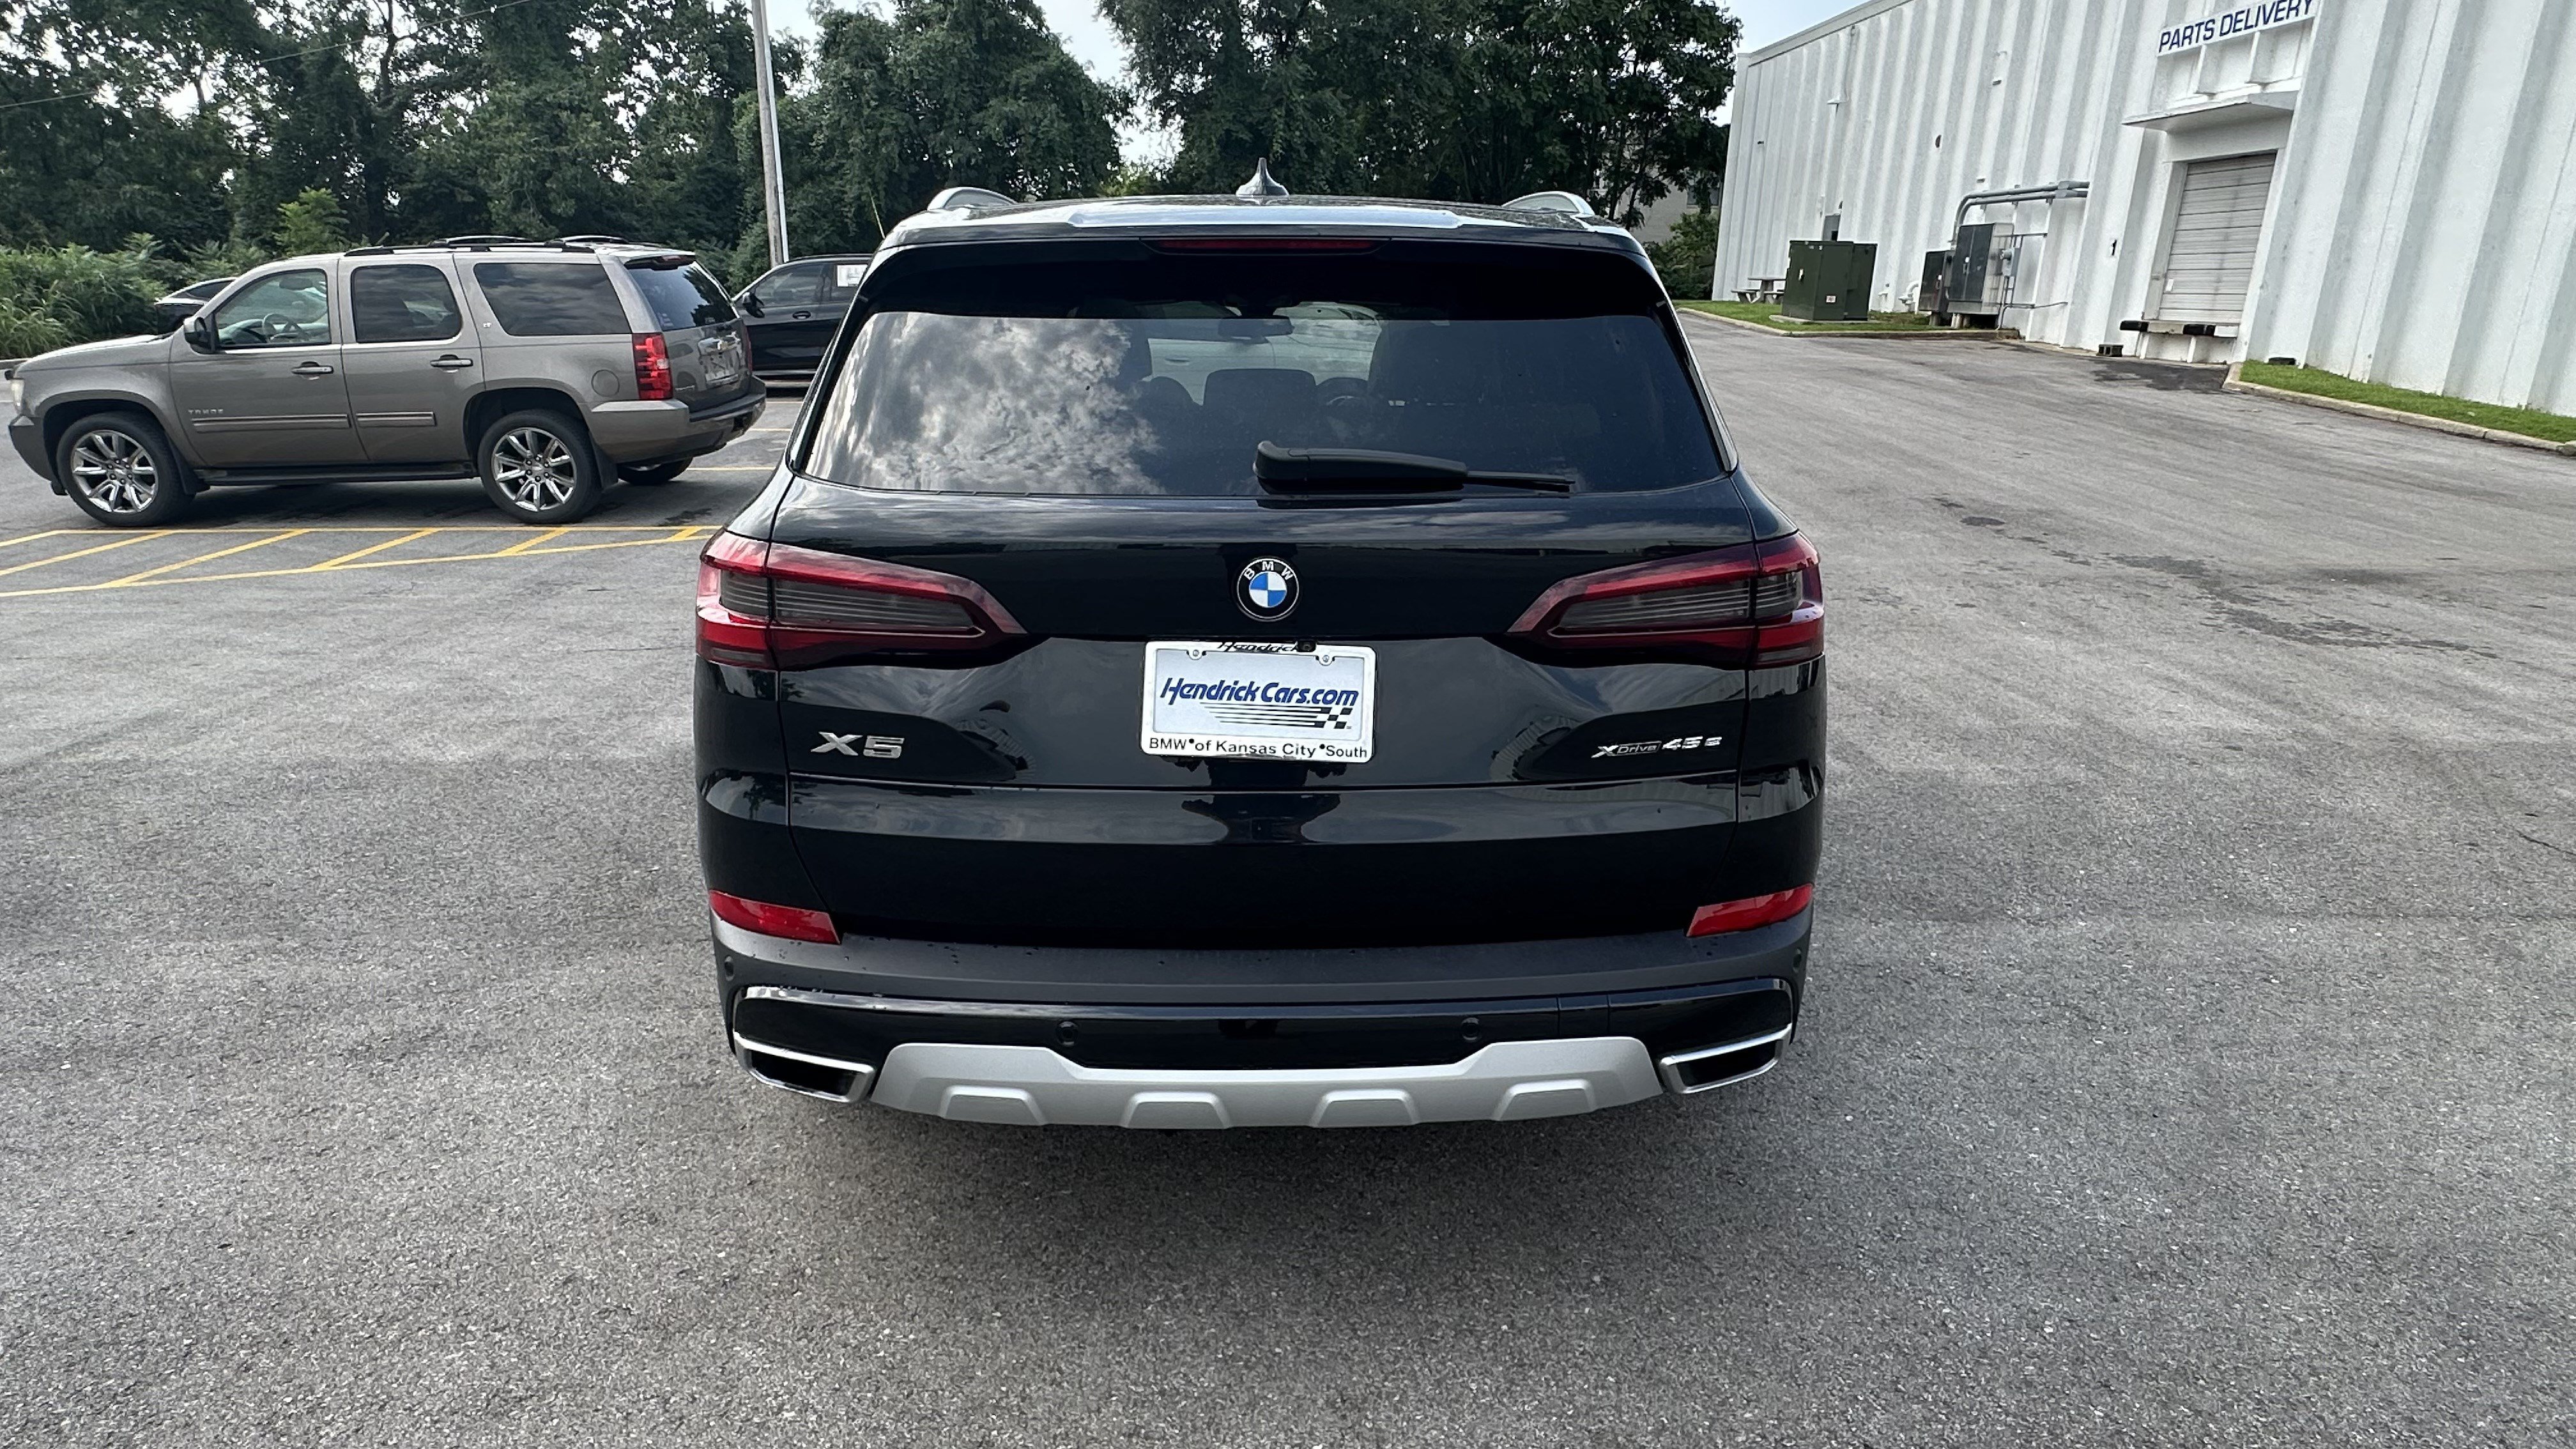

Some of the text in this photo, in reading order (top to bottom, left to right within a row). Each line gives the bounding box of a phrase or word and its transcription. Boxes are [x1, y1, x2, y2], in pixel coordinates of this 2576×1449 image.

[2158, 0, 2313, 53] PARTS DELIVERY
[1244, 561, 1294, 580] BMW
[811, 732, 905, 758] X5
[1149, 737, 1367, 758] BMW of Kansas City South
